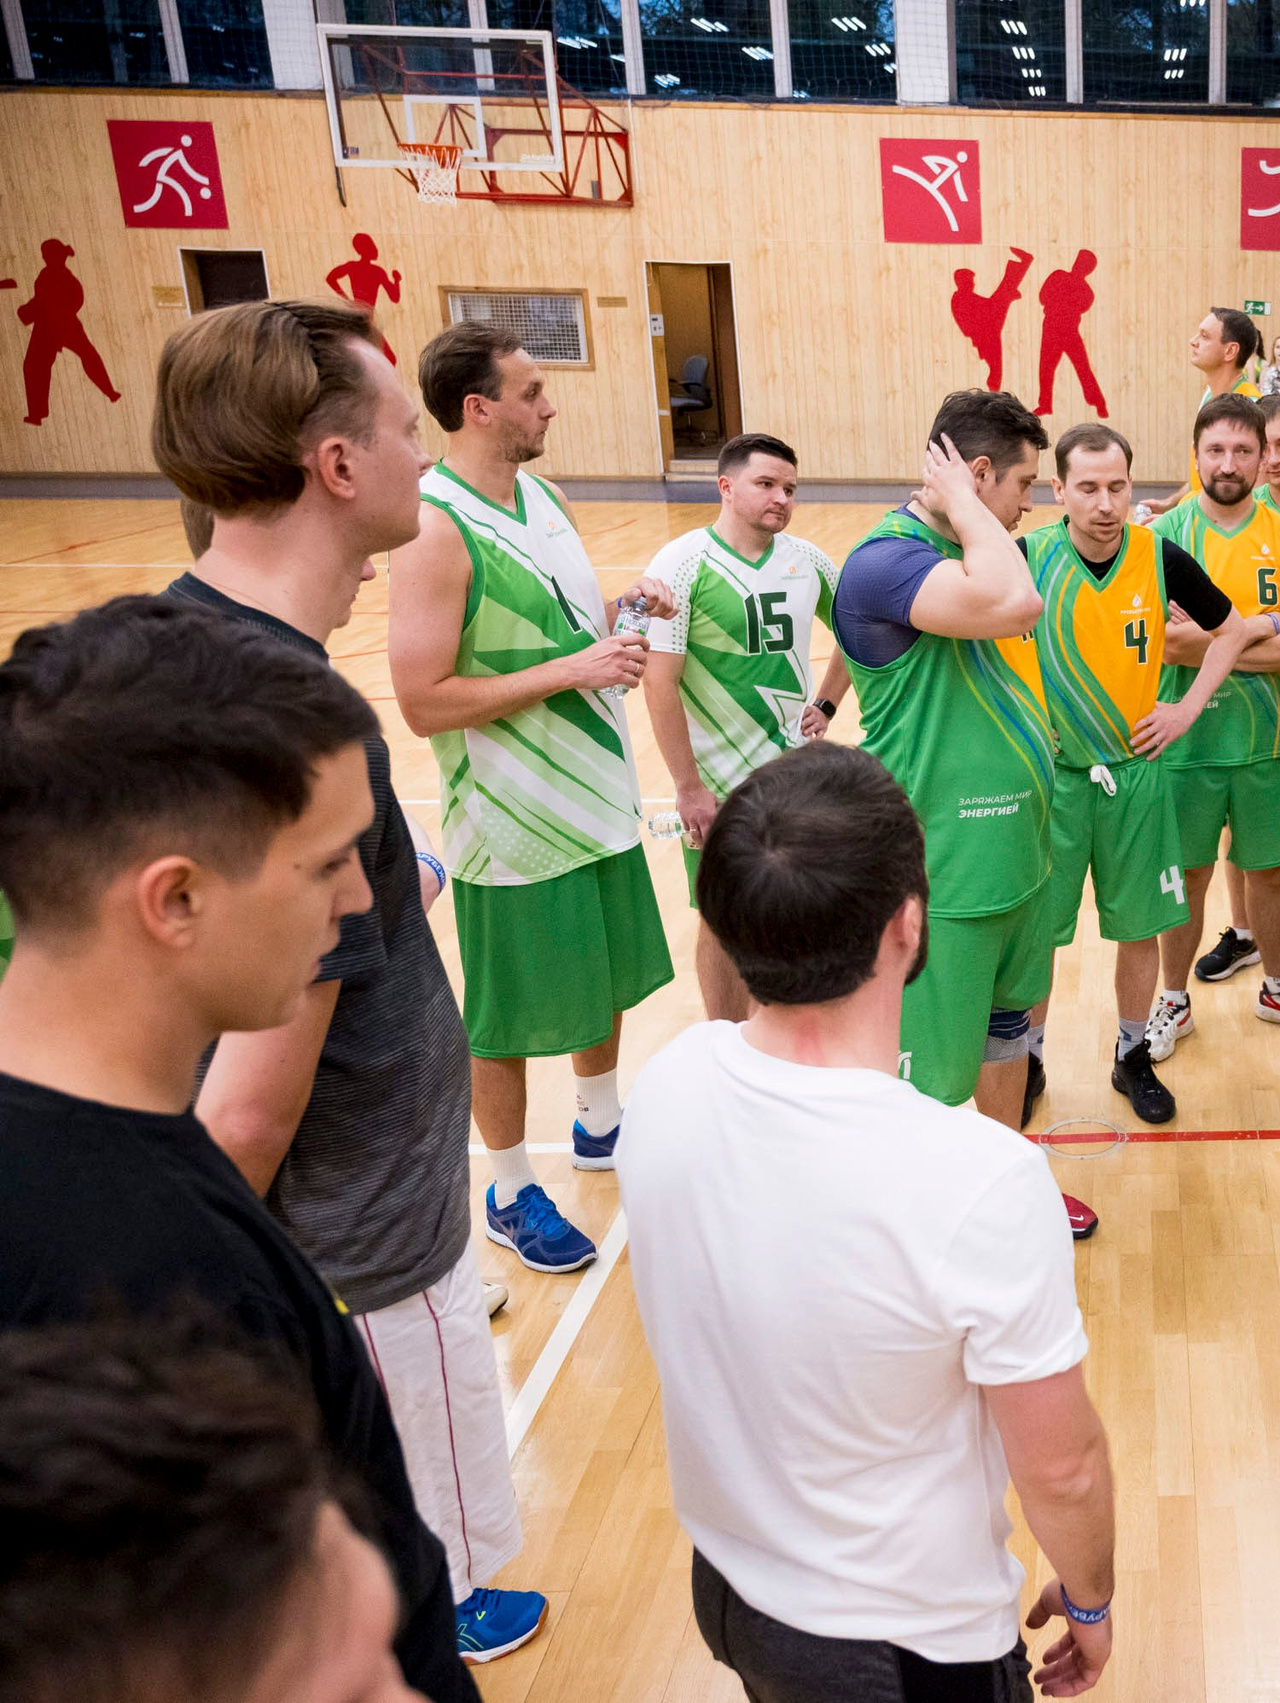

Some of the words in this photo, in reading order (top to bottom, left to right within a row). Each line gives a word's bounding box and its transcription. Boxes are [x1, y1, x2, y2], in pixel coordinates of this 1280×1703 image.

[1257, 567, 1278, 607] 6
[743, 590, 795, 655] 15
[1124, 617, 1150, 665] 4
[957, 793, 1014, 806] ЗАРЯЖАЕМ
[1014, 789, 1033, 800] МИР
[957, 802, 1020, 819] ЭНЕРГИЕЙ
[1159, 864, 1186, 906] 4
